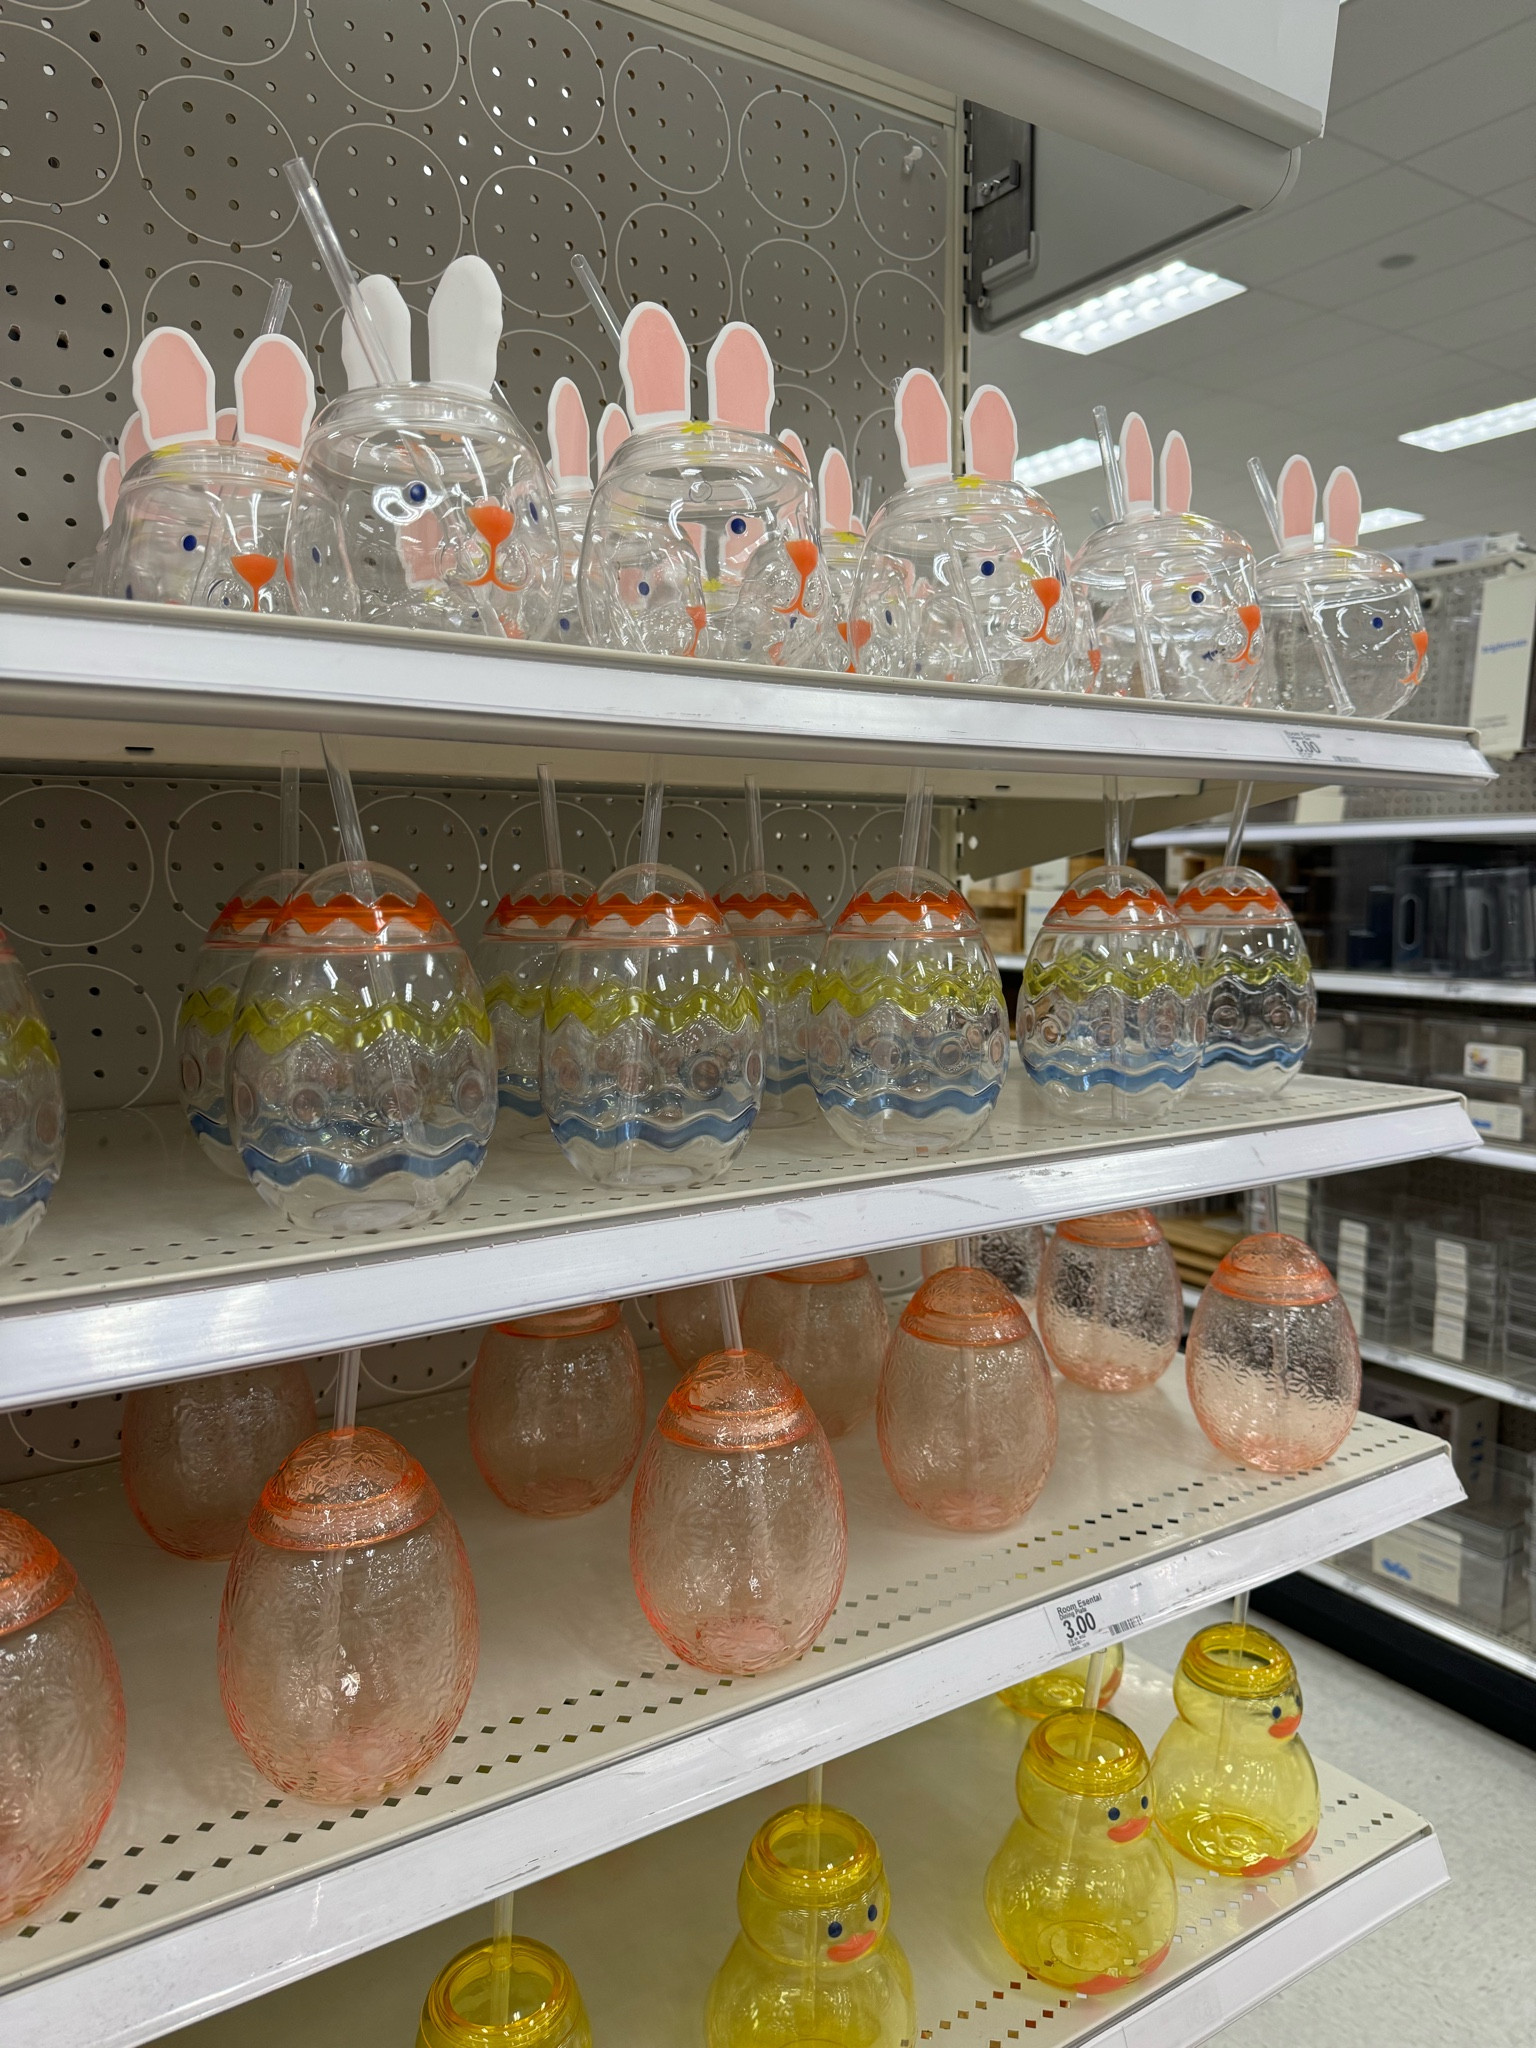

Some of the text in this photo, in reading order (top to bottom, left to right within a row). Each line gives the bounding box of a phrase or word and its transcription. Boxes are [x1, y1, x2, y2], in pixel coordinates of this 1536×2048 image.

[1291, 740, 1321, 754] 3.00
[1056, 1603, 1077, 1616] Room
[1063, 1612, 1096, 1639] 3.00
